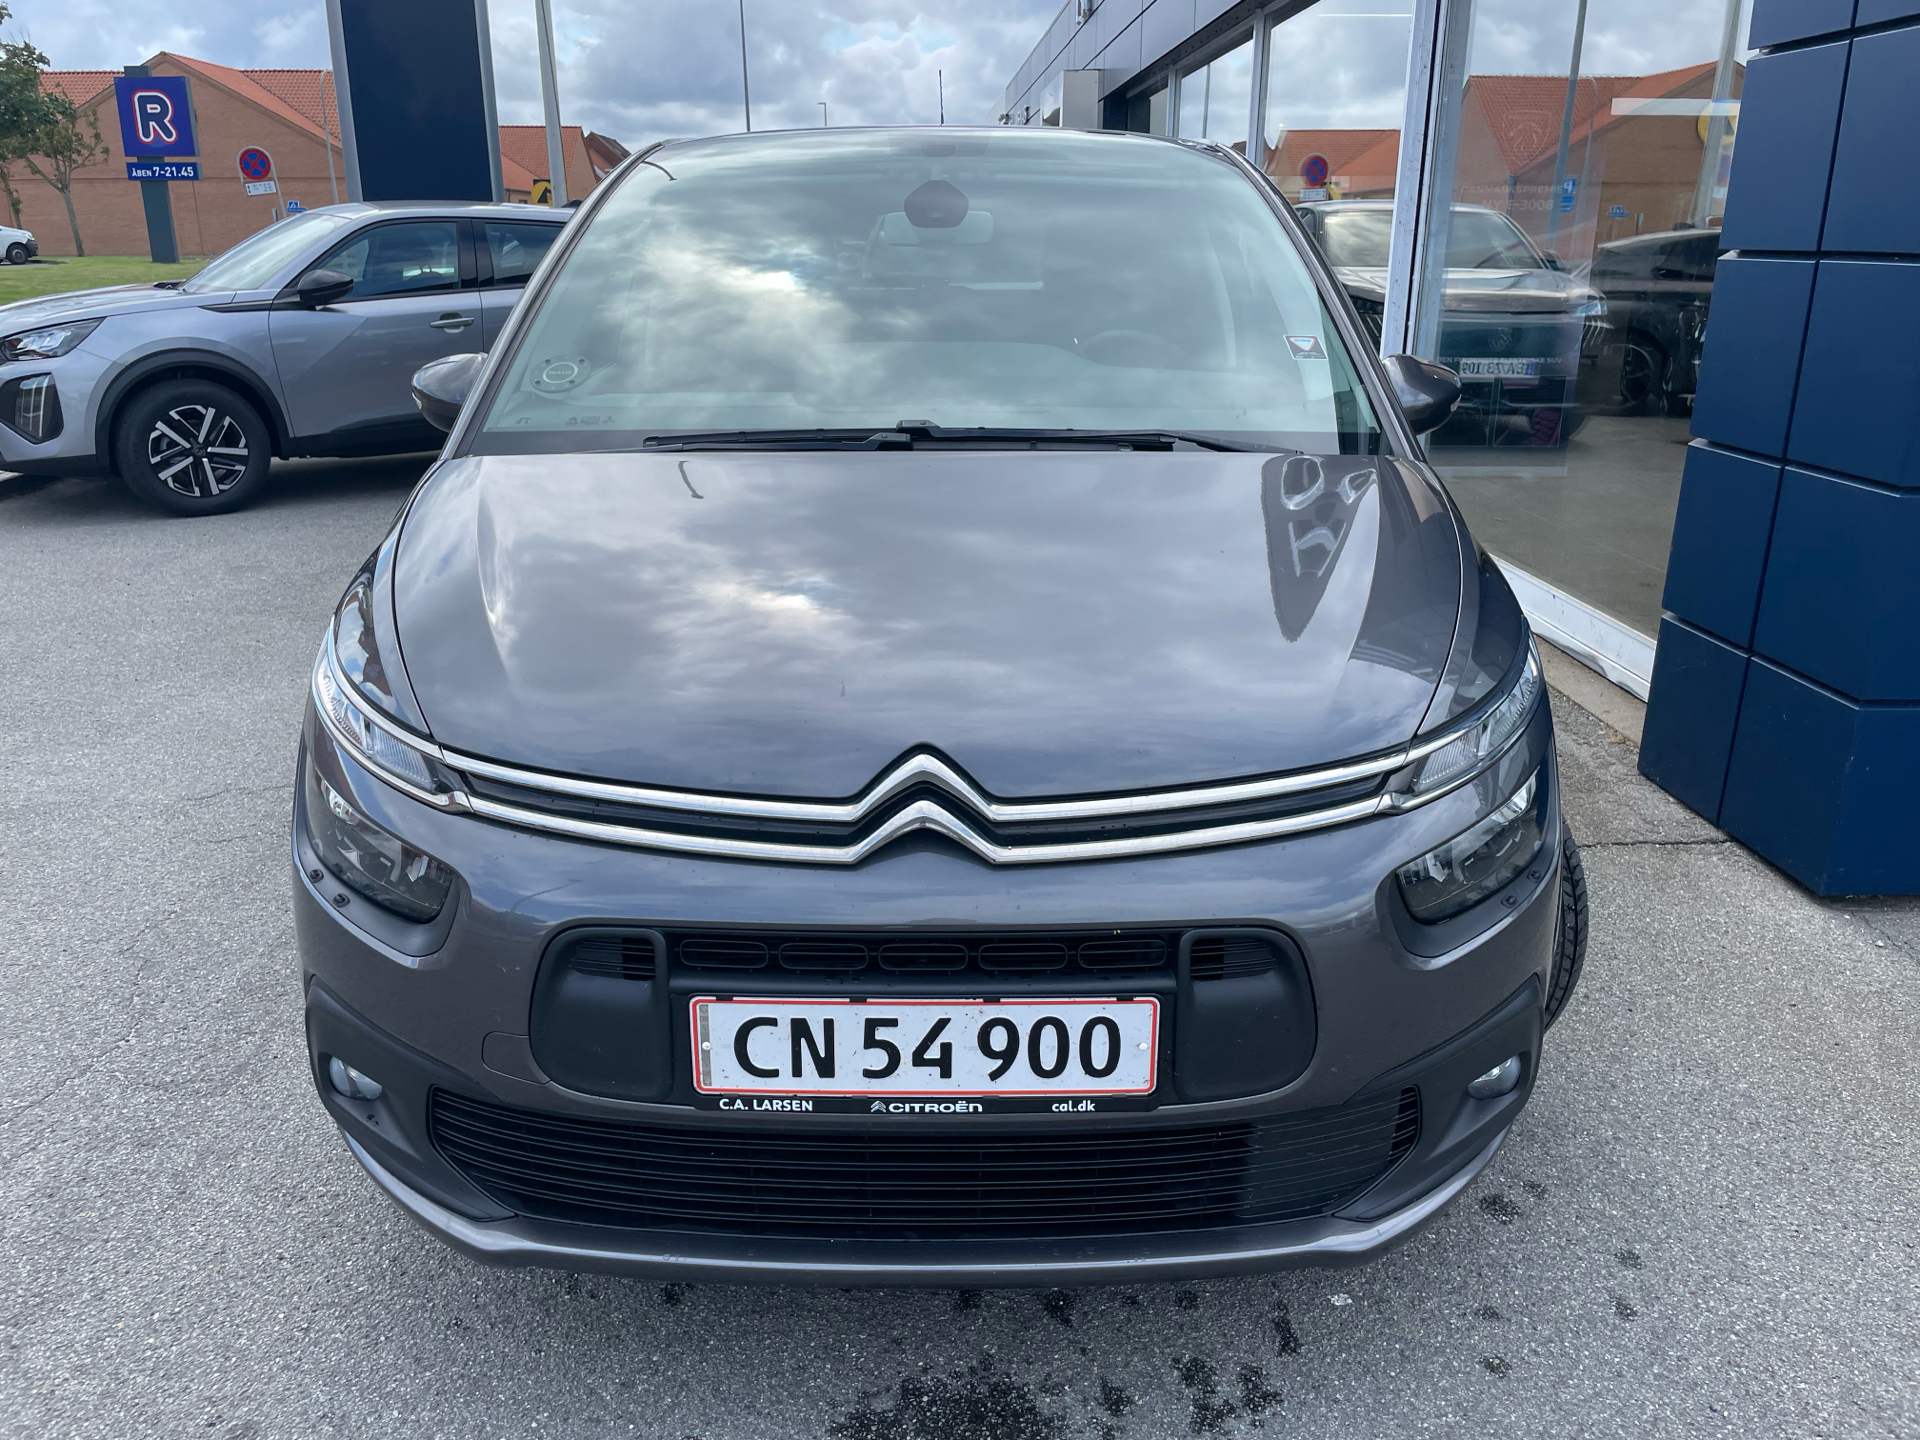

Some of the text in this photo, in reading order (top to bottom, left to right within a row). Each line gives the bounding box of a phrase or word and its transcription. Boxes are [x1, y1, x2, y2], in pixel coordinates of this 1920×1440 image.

[133, 90, 177, 143] R
[131, 166, 194, 177] ÅBEN 7-21.45
[733, 1016, 1122, 1082] CN 54 900
[719, 1098, 813, 1111] C.A. LARSEN
[1051, 1099, 1096, 1112] cal.dk
